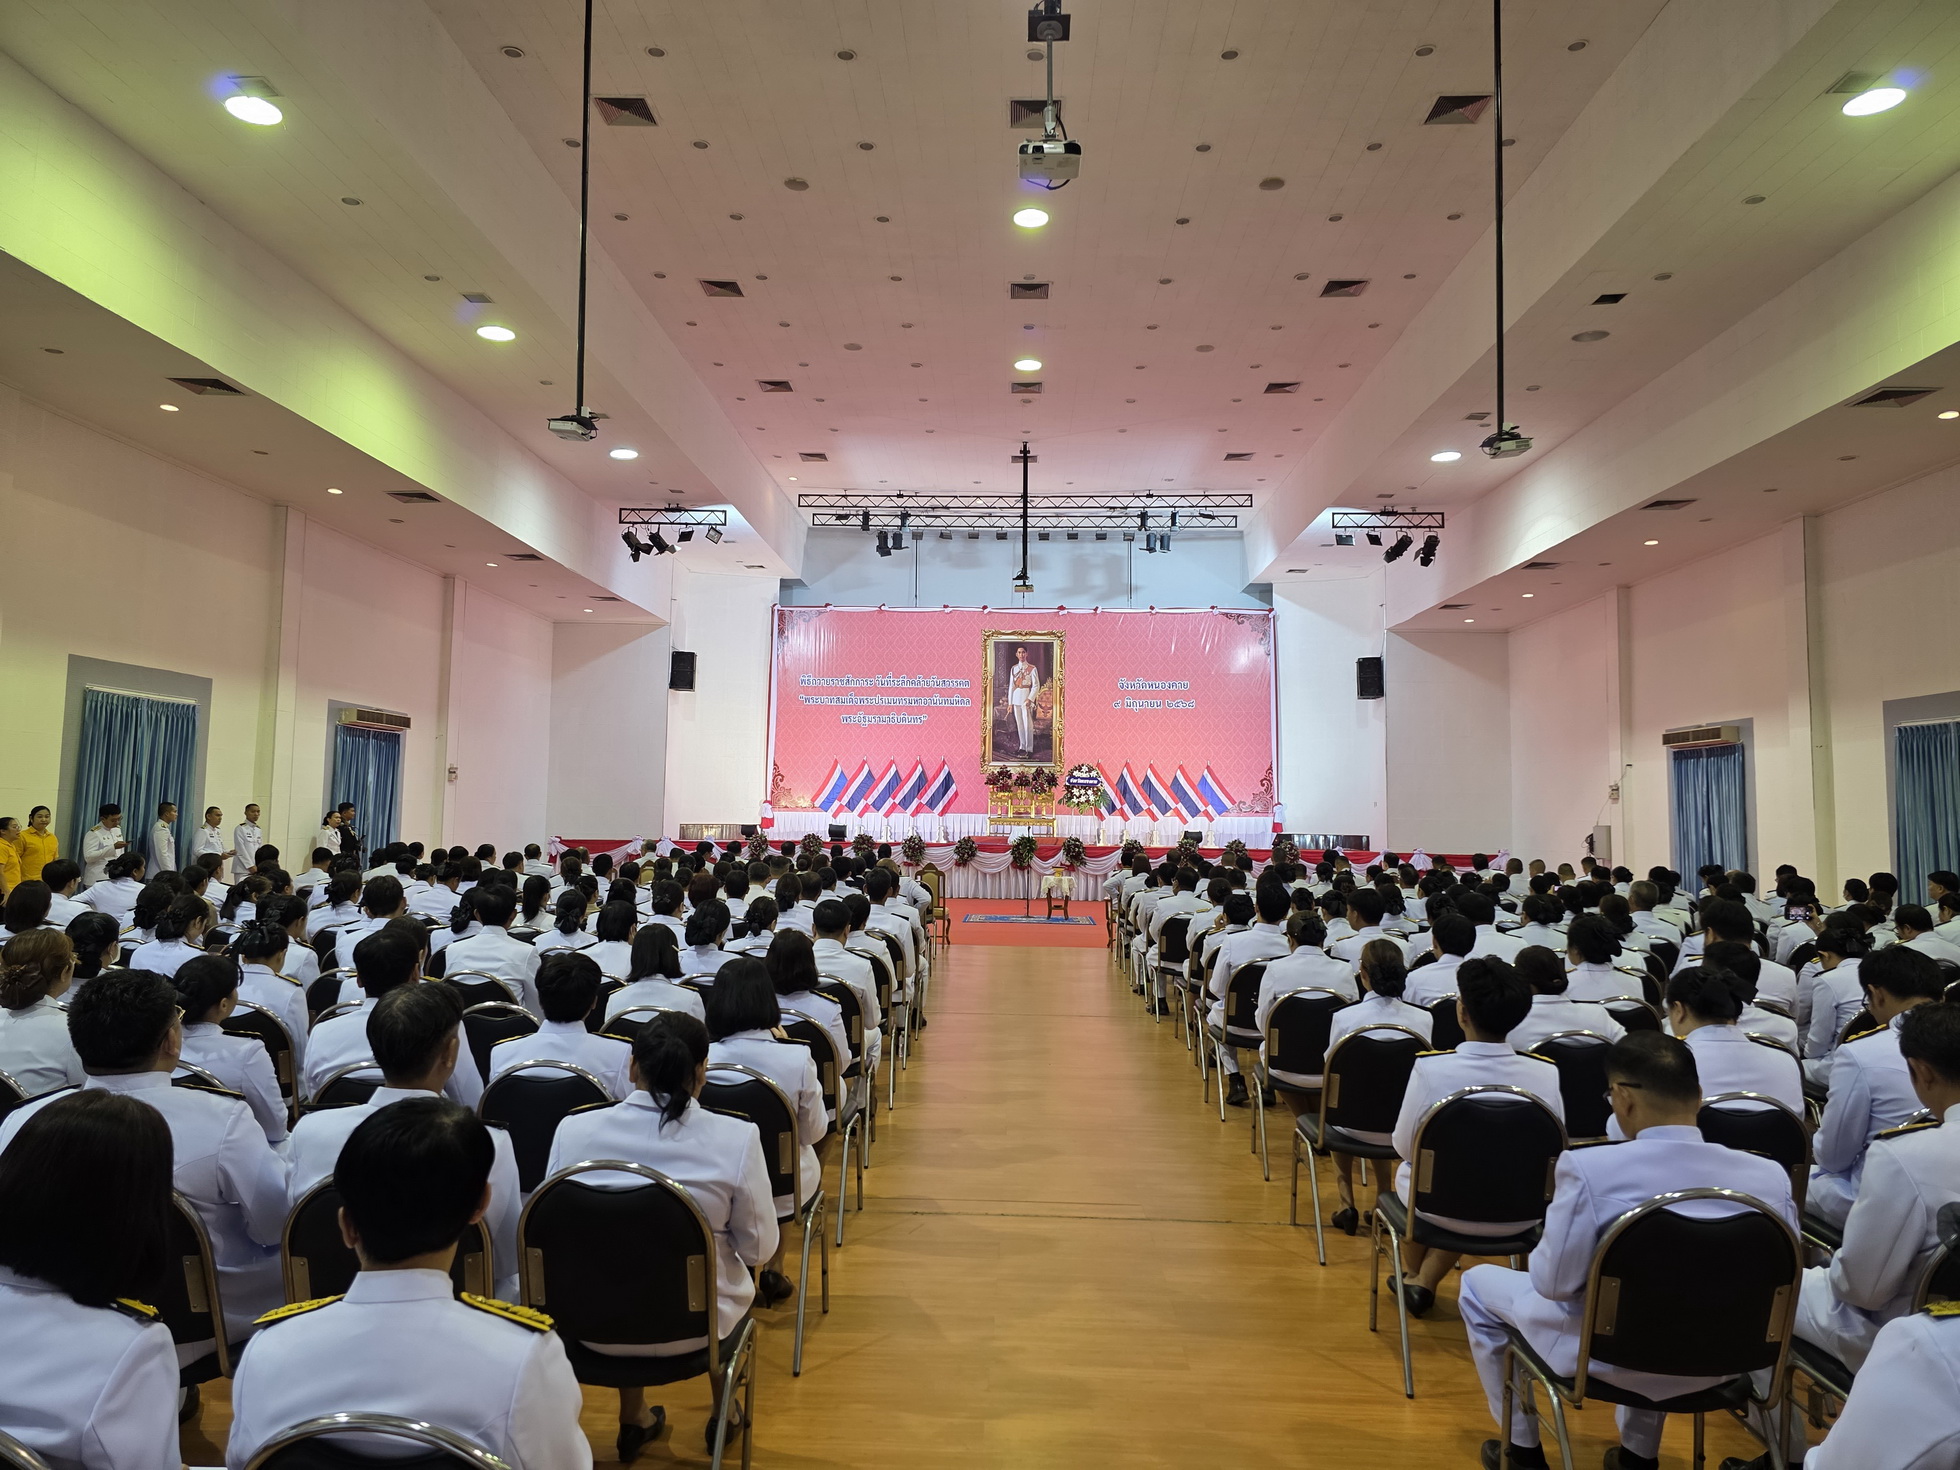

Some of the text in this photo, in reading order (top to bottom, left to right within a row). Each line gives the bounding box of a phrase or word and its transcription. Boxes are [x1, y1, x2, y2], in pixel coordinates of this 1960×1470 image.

[1118, 677, 1189, 690] จังหวัดหนองคาย
[1124, 696, 1162, 712] มิถุนายน
[1166, 699, 1195, 709] ๒๕๖๘
